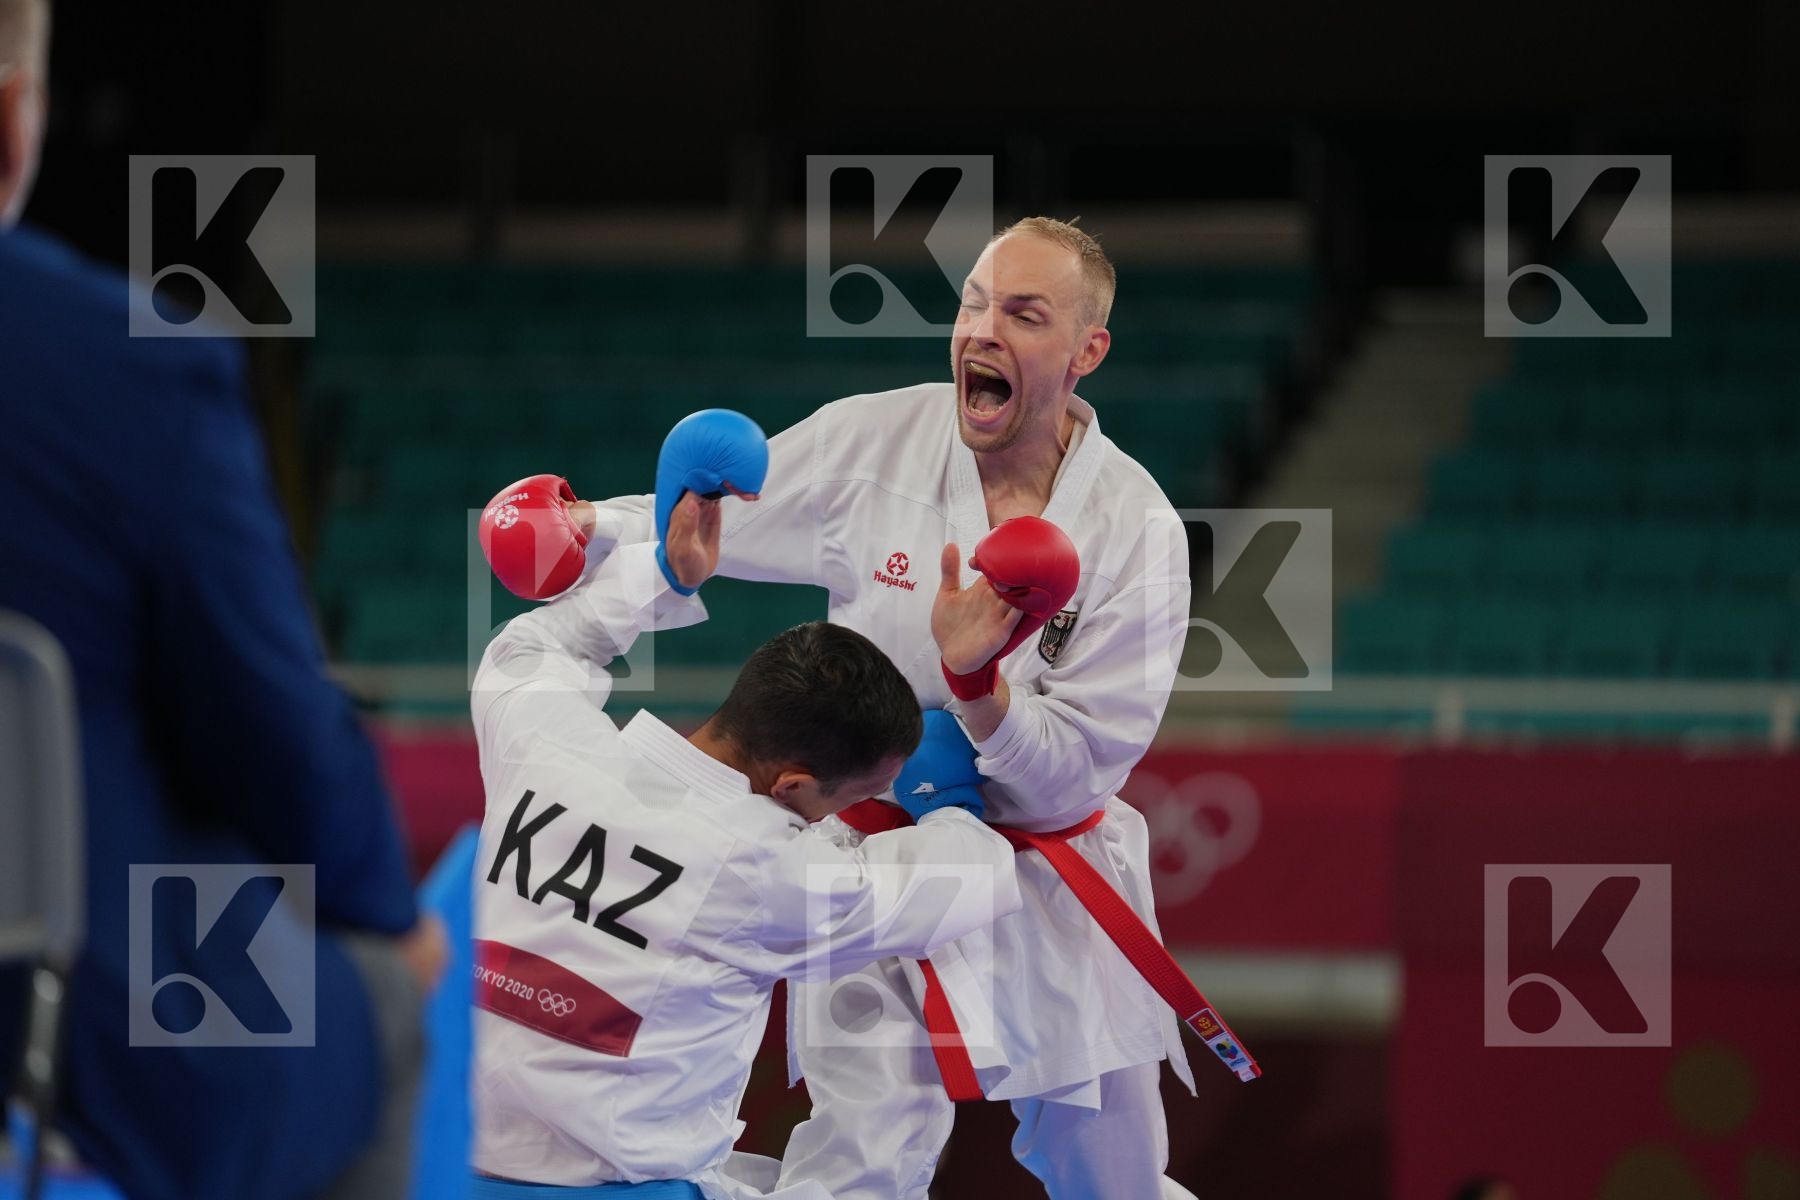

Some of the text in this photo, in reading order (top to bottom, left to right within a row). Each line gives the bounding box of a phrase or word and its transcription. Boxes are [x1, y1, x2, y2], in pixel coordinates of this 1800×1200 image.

[873, 570, 918, 592] Hayashi
[486, 789, 685, 951] KAZ
[504, 978, 535, 1001] 2020
